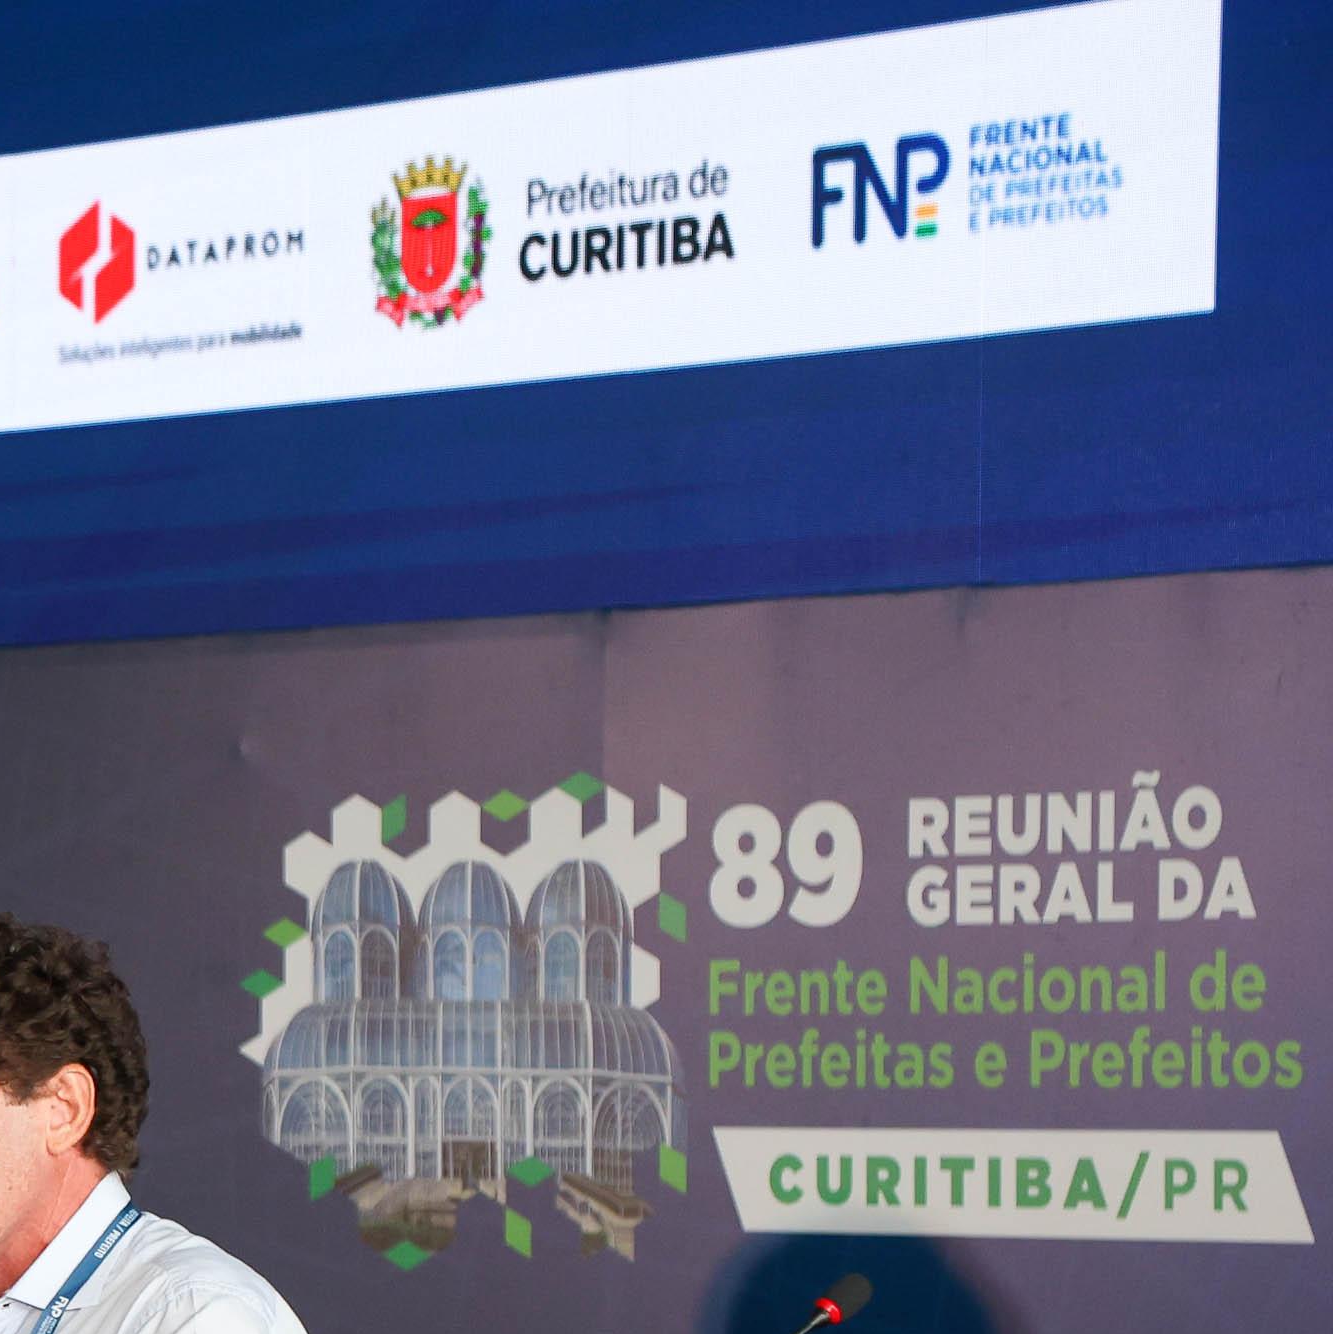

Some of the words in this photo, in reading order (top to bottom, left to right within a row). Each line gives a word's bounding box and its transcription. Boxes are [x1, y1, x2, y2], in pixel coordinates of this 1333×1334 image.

[968, 138, 1108, 177] NACIONAL
[969, 111, 1071, 148] FRENTE
[527, 163, 680, 217] Prefeitura
[690, 160, 729, 199] de
[148, 230, 305, 271] DATAPROM
[519, 211, 735, 284] CURITIBA
[907, 770, 1222, 857] REUNIÃO
[709, 800, 863, 928] 89
[906, 861, 1134, 928] GERAL
[1159, 857, 1257, 921] DA
[708, 956, 888, 1017] Frente
[909, 948, 1169, 1014] Nacional
[1190, 948, 1266, 1014] de
[708, 1023, 955, 1091] Prefeitas
[974, 1039, 1005, 1088] e
[1030, 1025, 1305, 1091] Prefeitos
[770, 1149, 1250, 1218] CURITIBA/PR
